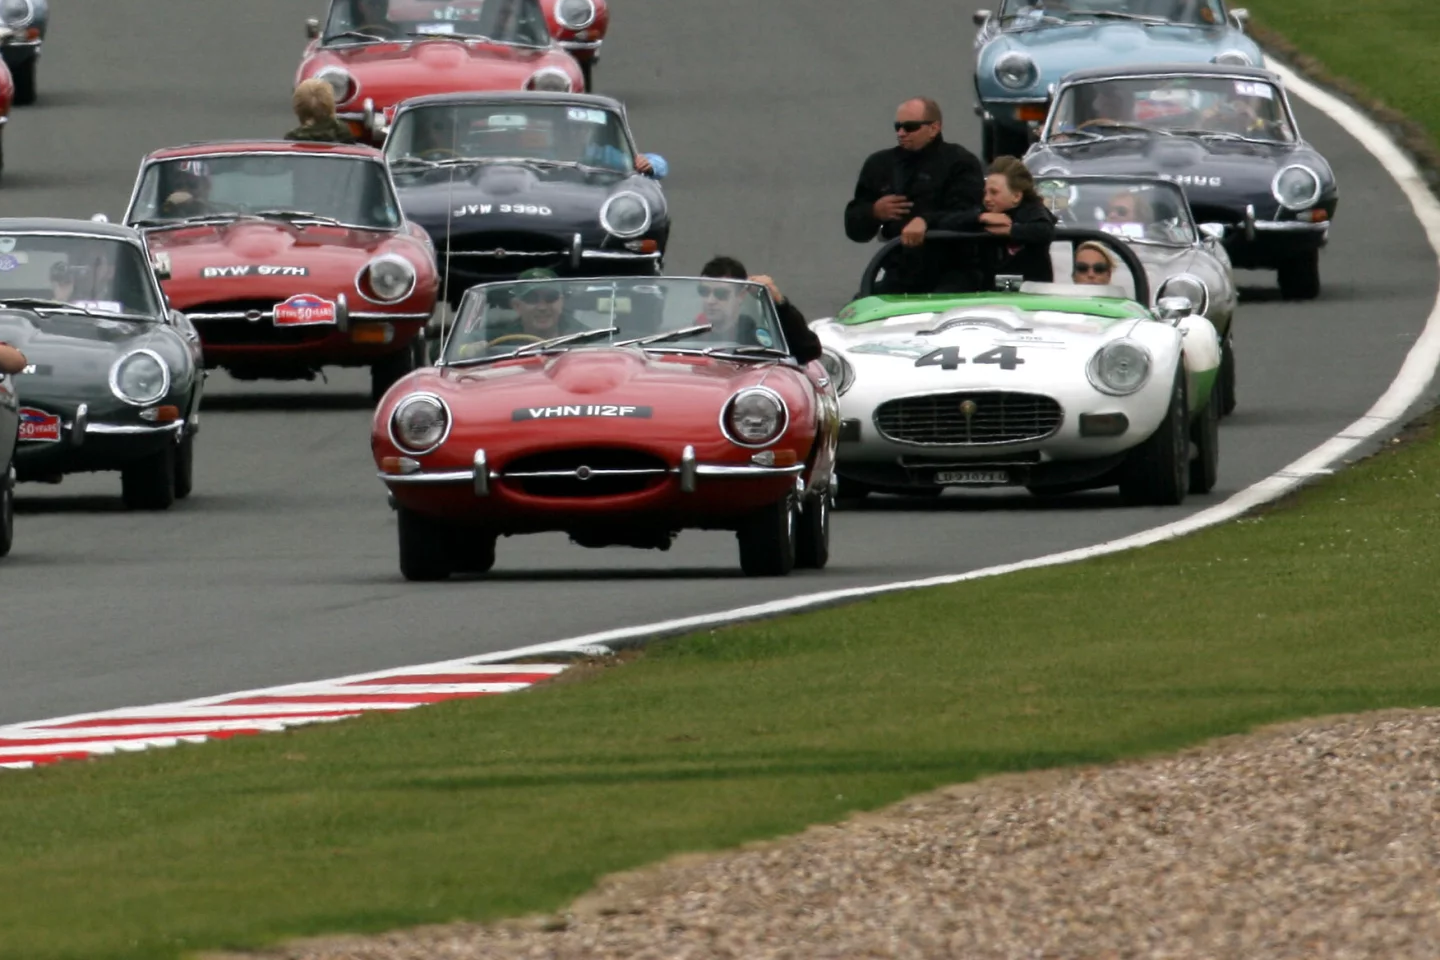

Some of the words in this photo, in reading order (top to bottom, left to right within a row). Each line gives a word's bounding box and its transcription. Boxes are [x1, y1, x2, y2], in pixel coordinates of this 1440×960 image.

[203, 265, 249, 277] BYW
[258, 264, 305, 276] 977H
[297, 307, 312, 320] 50
[914, 345, 1025, 371] 44
[528, 405, 581, 418] VHN
[586, 404, 637, 416] 112F
